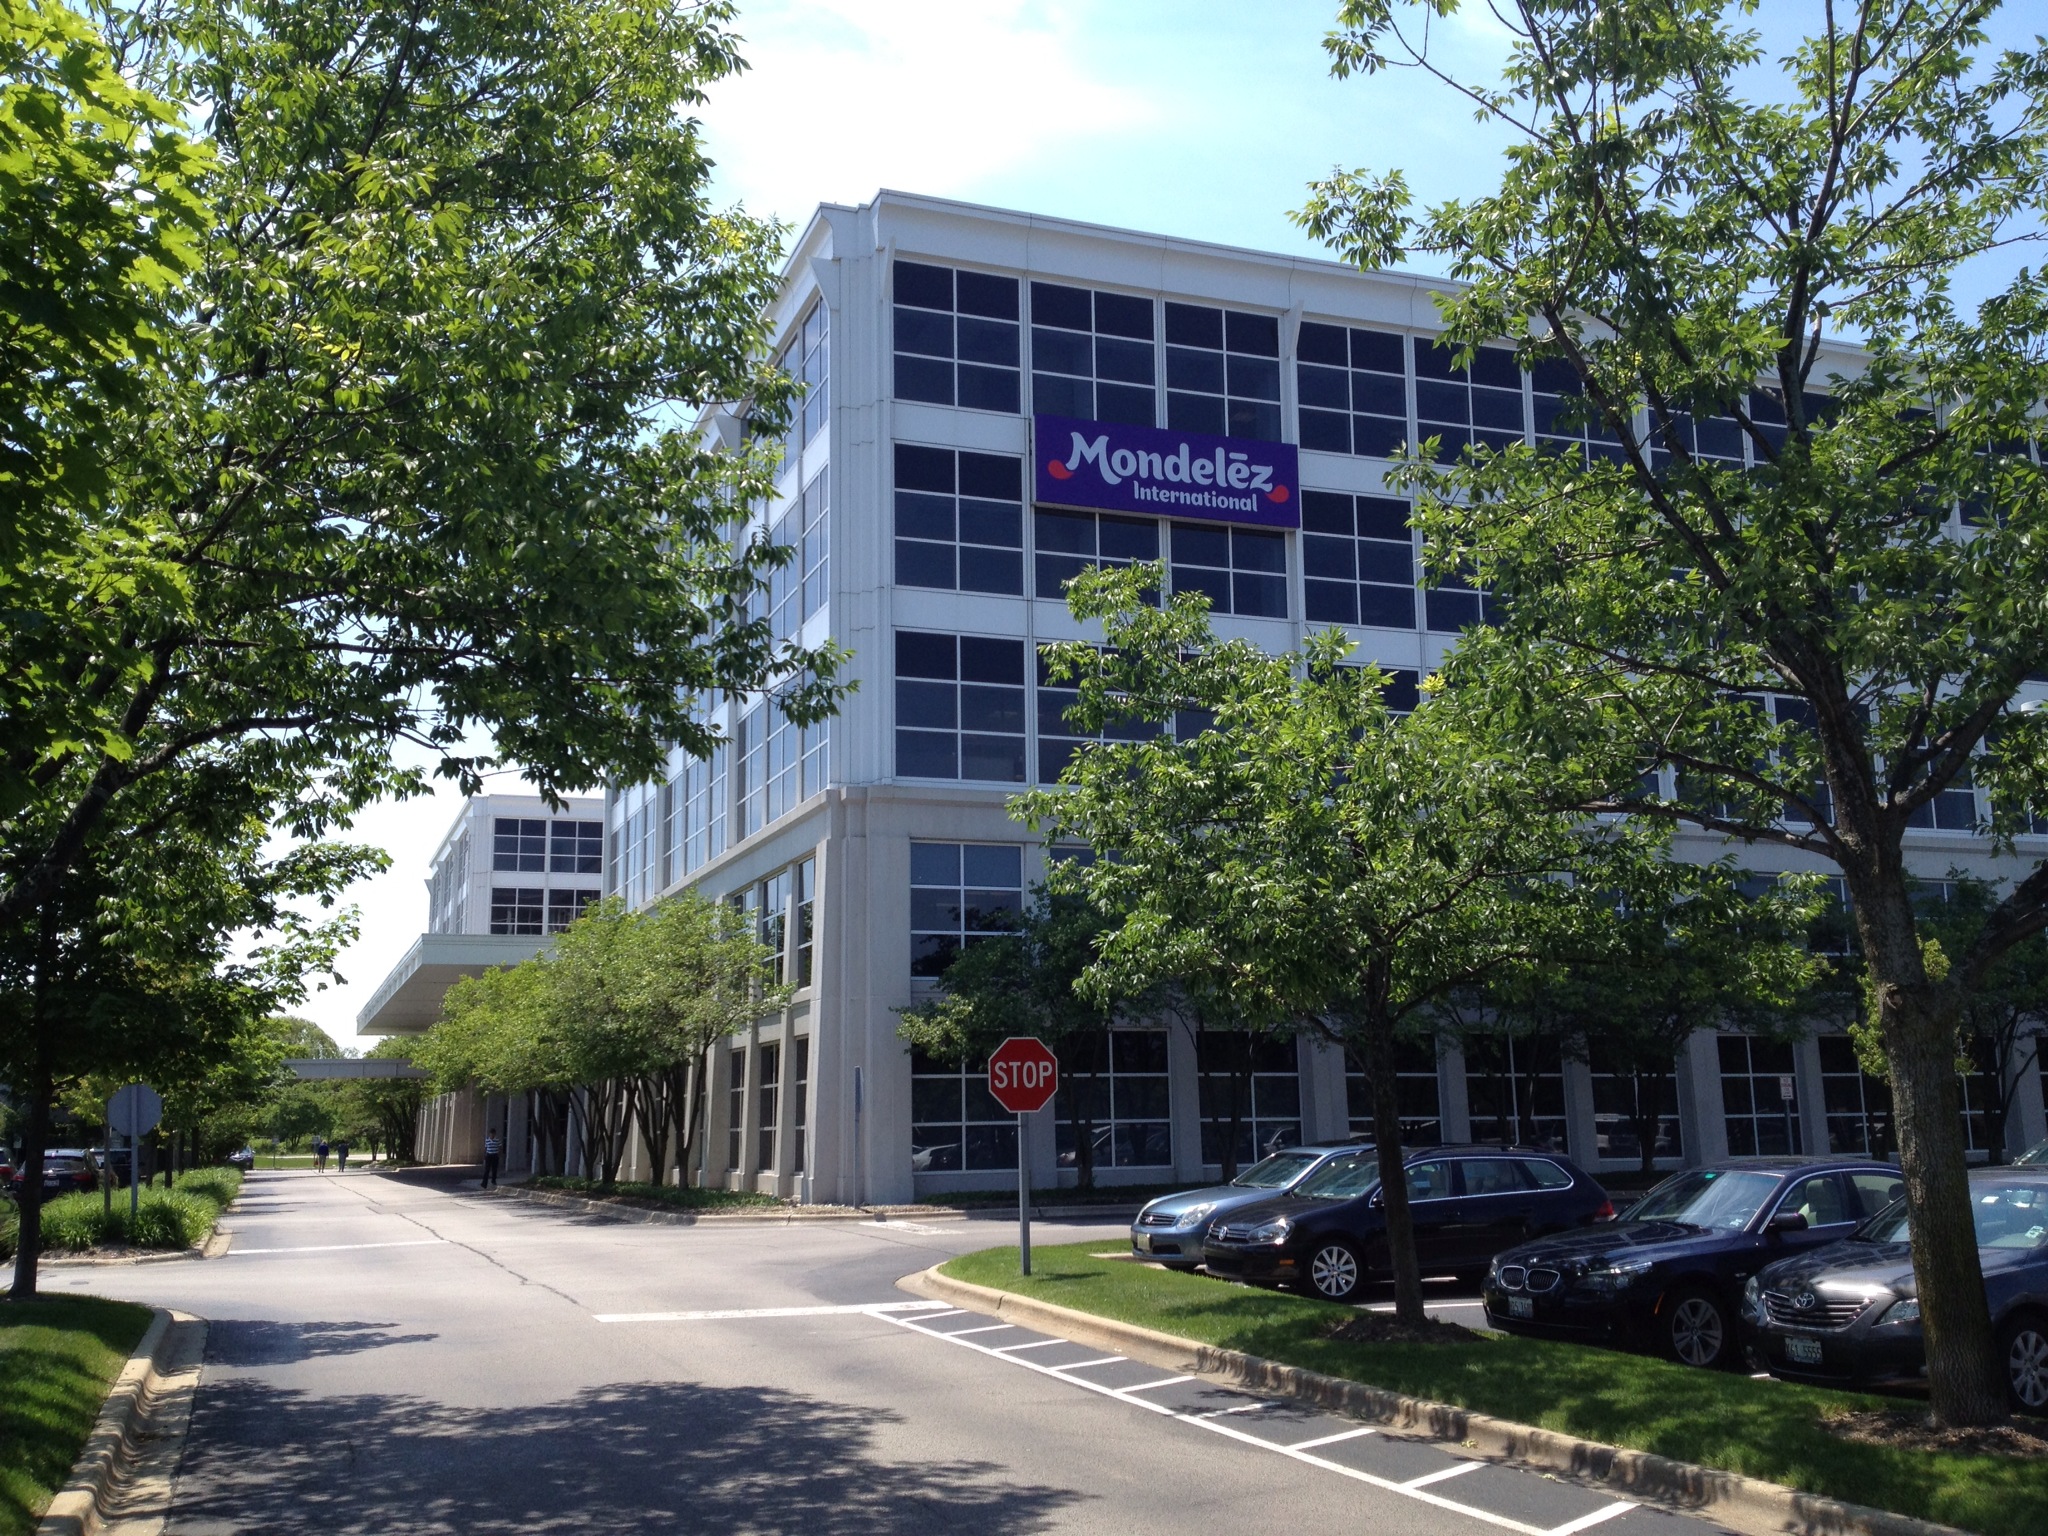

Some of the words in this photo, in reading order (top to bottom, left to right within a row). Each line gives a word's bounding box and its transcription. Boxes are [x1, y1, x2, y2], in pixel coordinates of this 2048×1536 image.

[1066, 431, 1273, 492] Mondelēz
[1133, 481, 1258, 512] International
[994, 1061, 1053, 1089] STOP
